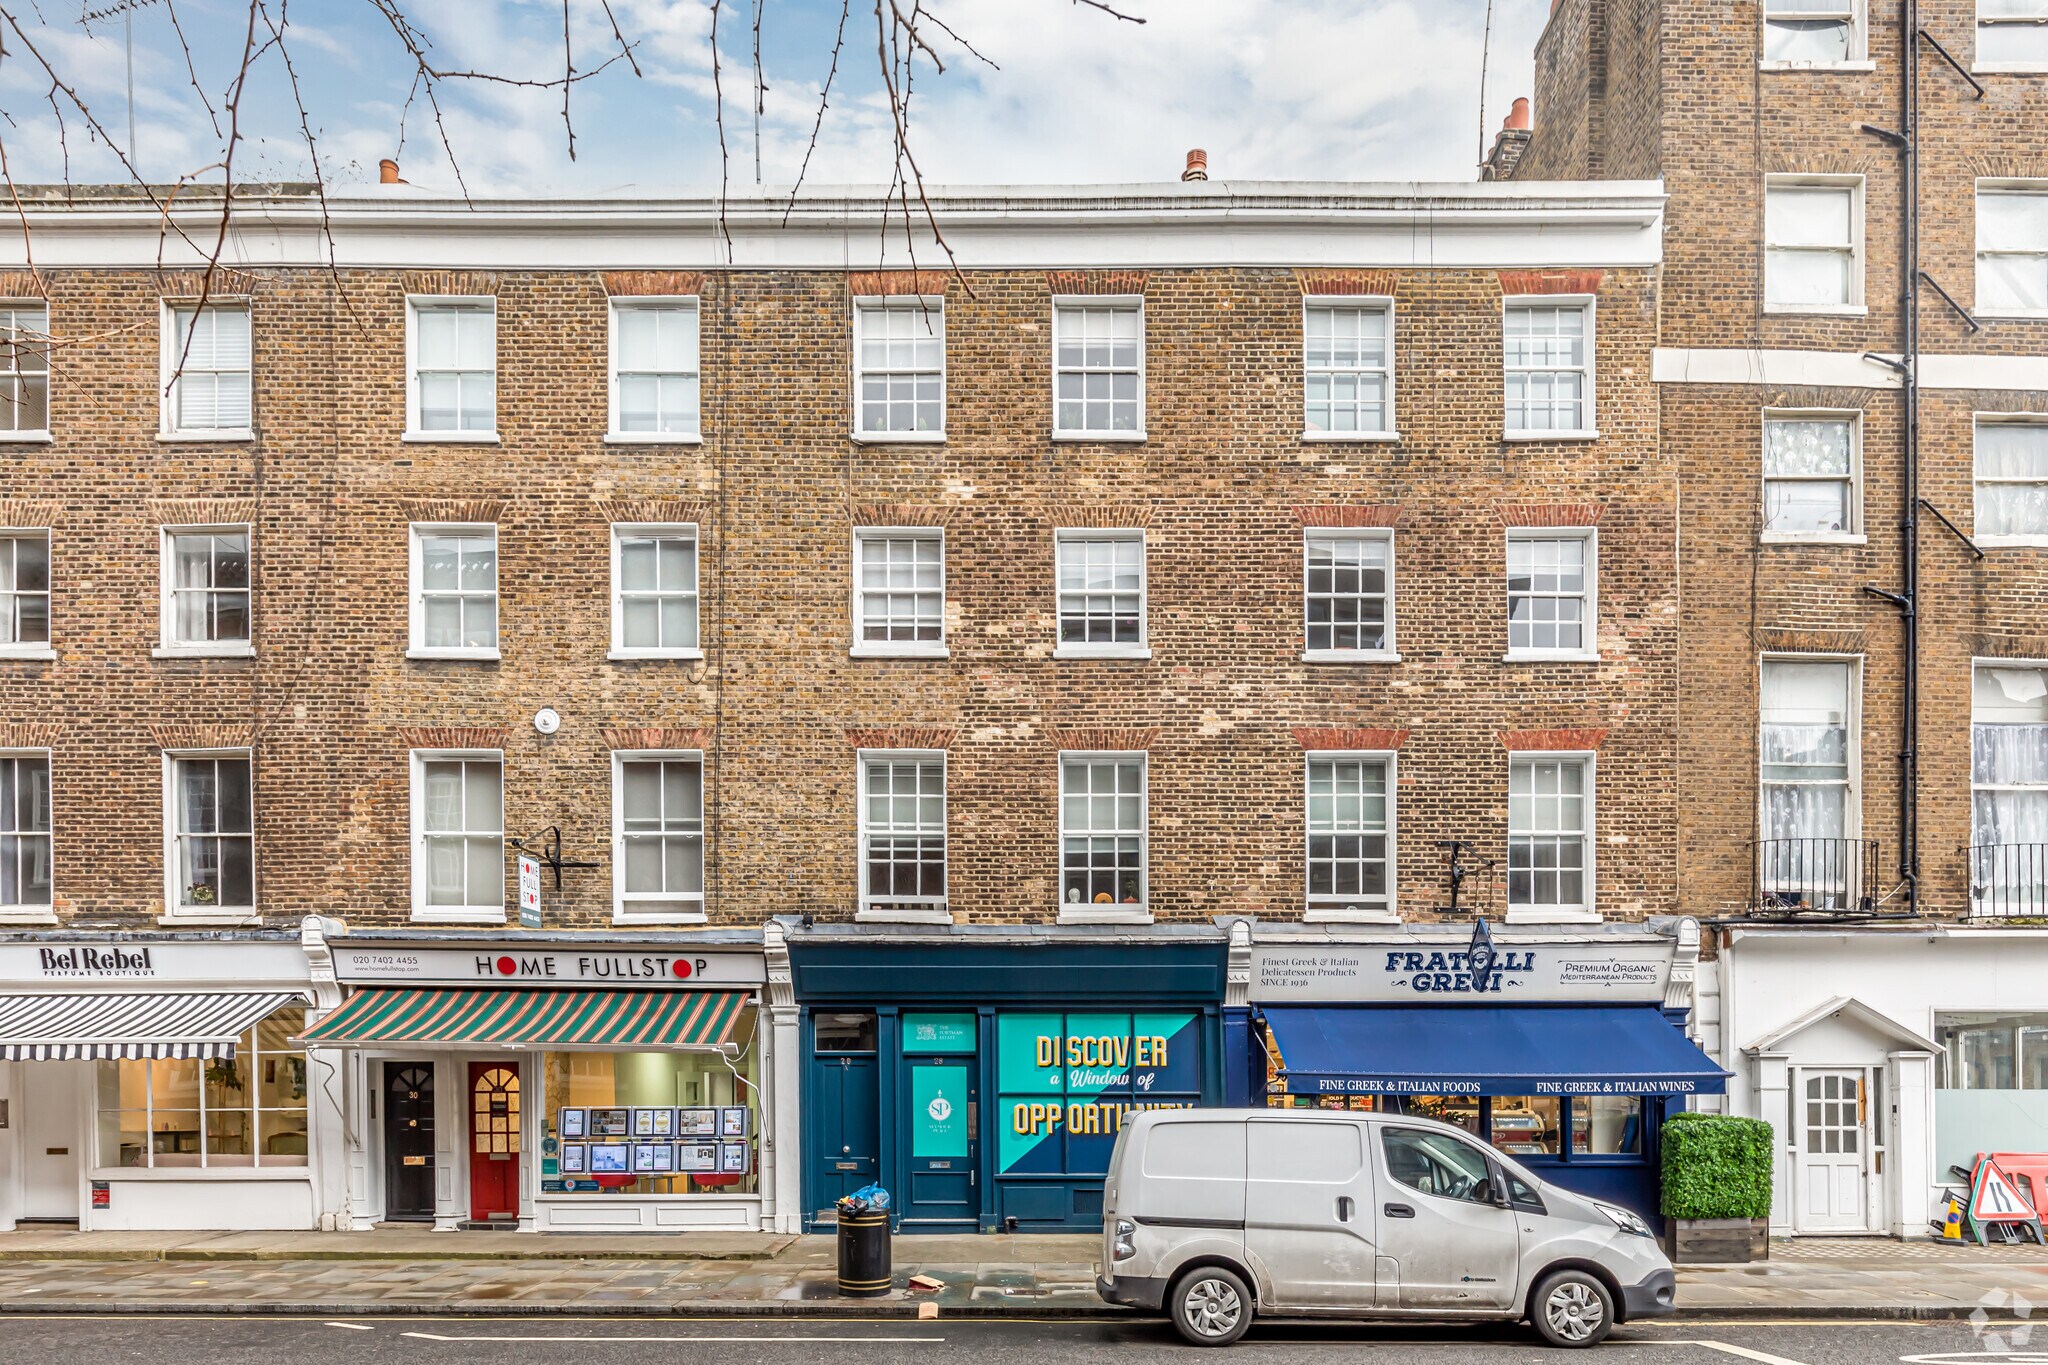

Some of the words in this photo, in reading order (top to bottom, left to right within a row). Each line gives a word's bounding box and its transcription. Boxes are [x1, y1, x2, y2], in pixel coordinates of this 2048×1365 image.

[39, 947, 79, 970] Bel
[82, 947, 152, 970] Rebel
[352, 956, 370, 964] 020
[372, 956, 394, 965] 7402
[396, 956, 418, 965] 4455
[1262, 958, 1289, 966] Finest
[1291, 958, 1318, 966] Greek
[1330, 958, 1359, 966] Italian
[1385, 952, 1537, 972] FRATLLI
[475, 956, 557, 976] HOME
[578, 957, 708, 979] FULLSTOP
[1261, 968, 1316, 976] Delicatessen
[1317, 968, 1357, 976] Products
[1565, 963, 1610, 972] PREMIUM
[1612, 963, 1656, 972] ORGANIC
[1260, 978, 1289, 987] SINCE
[1036, 1035, 1168, 1067] DISCOVER
[933, 1057, 943, 1065] 28
[1050, 1075, 1060, 1085] a
[1070, 1069, 1130, 1088] Window
[1137, 1072, 1155, 1091] of
[1319, 1079, 1345, 1090] FINE
[1347, 1080, 1384, 1091] GREEK
[1386, 1080, 1396, 1091] &
[1397, 1081, 1441, 1092] ITALIAN
[1442, 1081, 1481, 1093] FOODS
[1536, 1082, 1562, 1093] FINE
[1564, 1081, 1601, 1093] GREEK
[1603, 1081, 1613, 1093] &
[1614, 1081, 1658, 1092] ITALIAN
[1659, 1081, 1695, 1092] WINES
[408, 1091, 418, 1099] 30
[1013, 1103, 1194, 1134] OPPORTU
